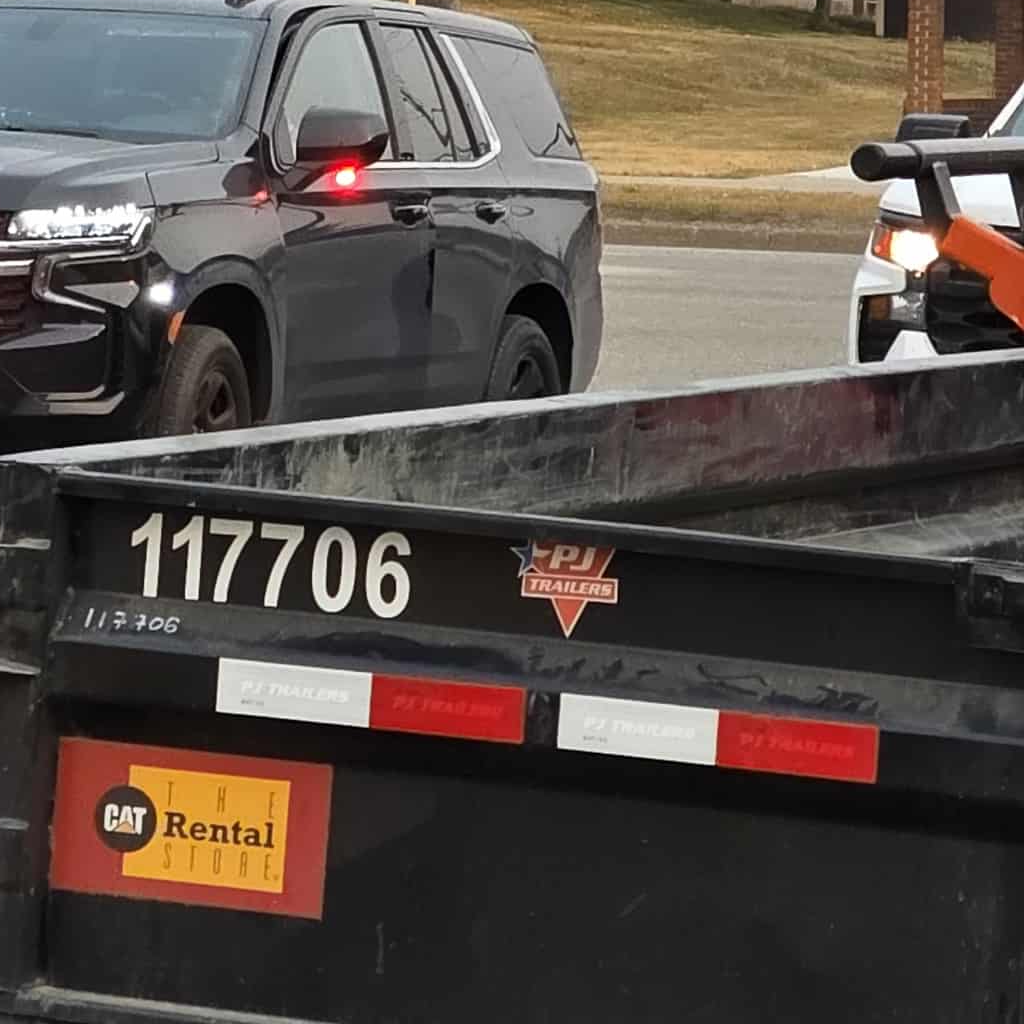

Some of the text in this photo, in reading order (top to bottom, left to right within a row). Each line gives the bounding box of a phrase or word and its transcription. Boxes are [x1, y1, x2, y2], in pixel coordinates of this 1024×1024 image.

[130, 512, 412, 619] 117706
[548, 543, 597, 572] PJ
[528, 577, 614, 597] TRAILERS
[167, 780, 276, 820] THE
[103, 803, 275, 849] CAT Rental
